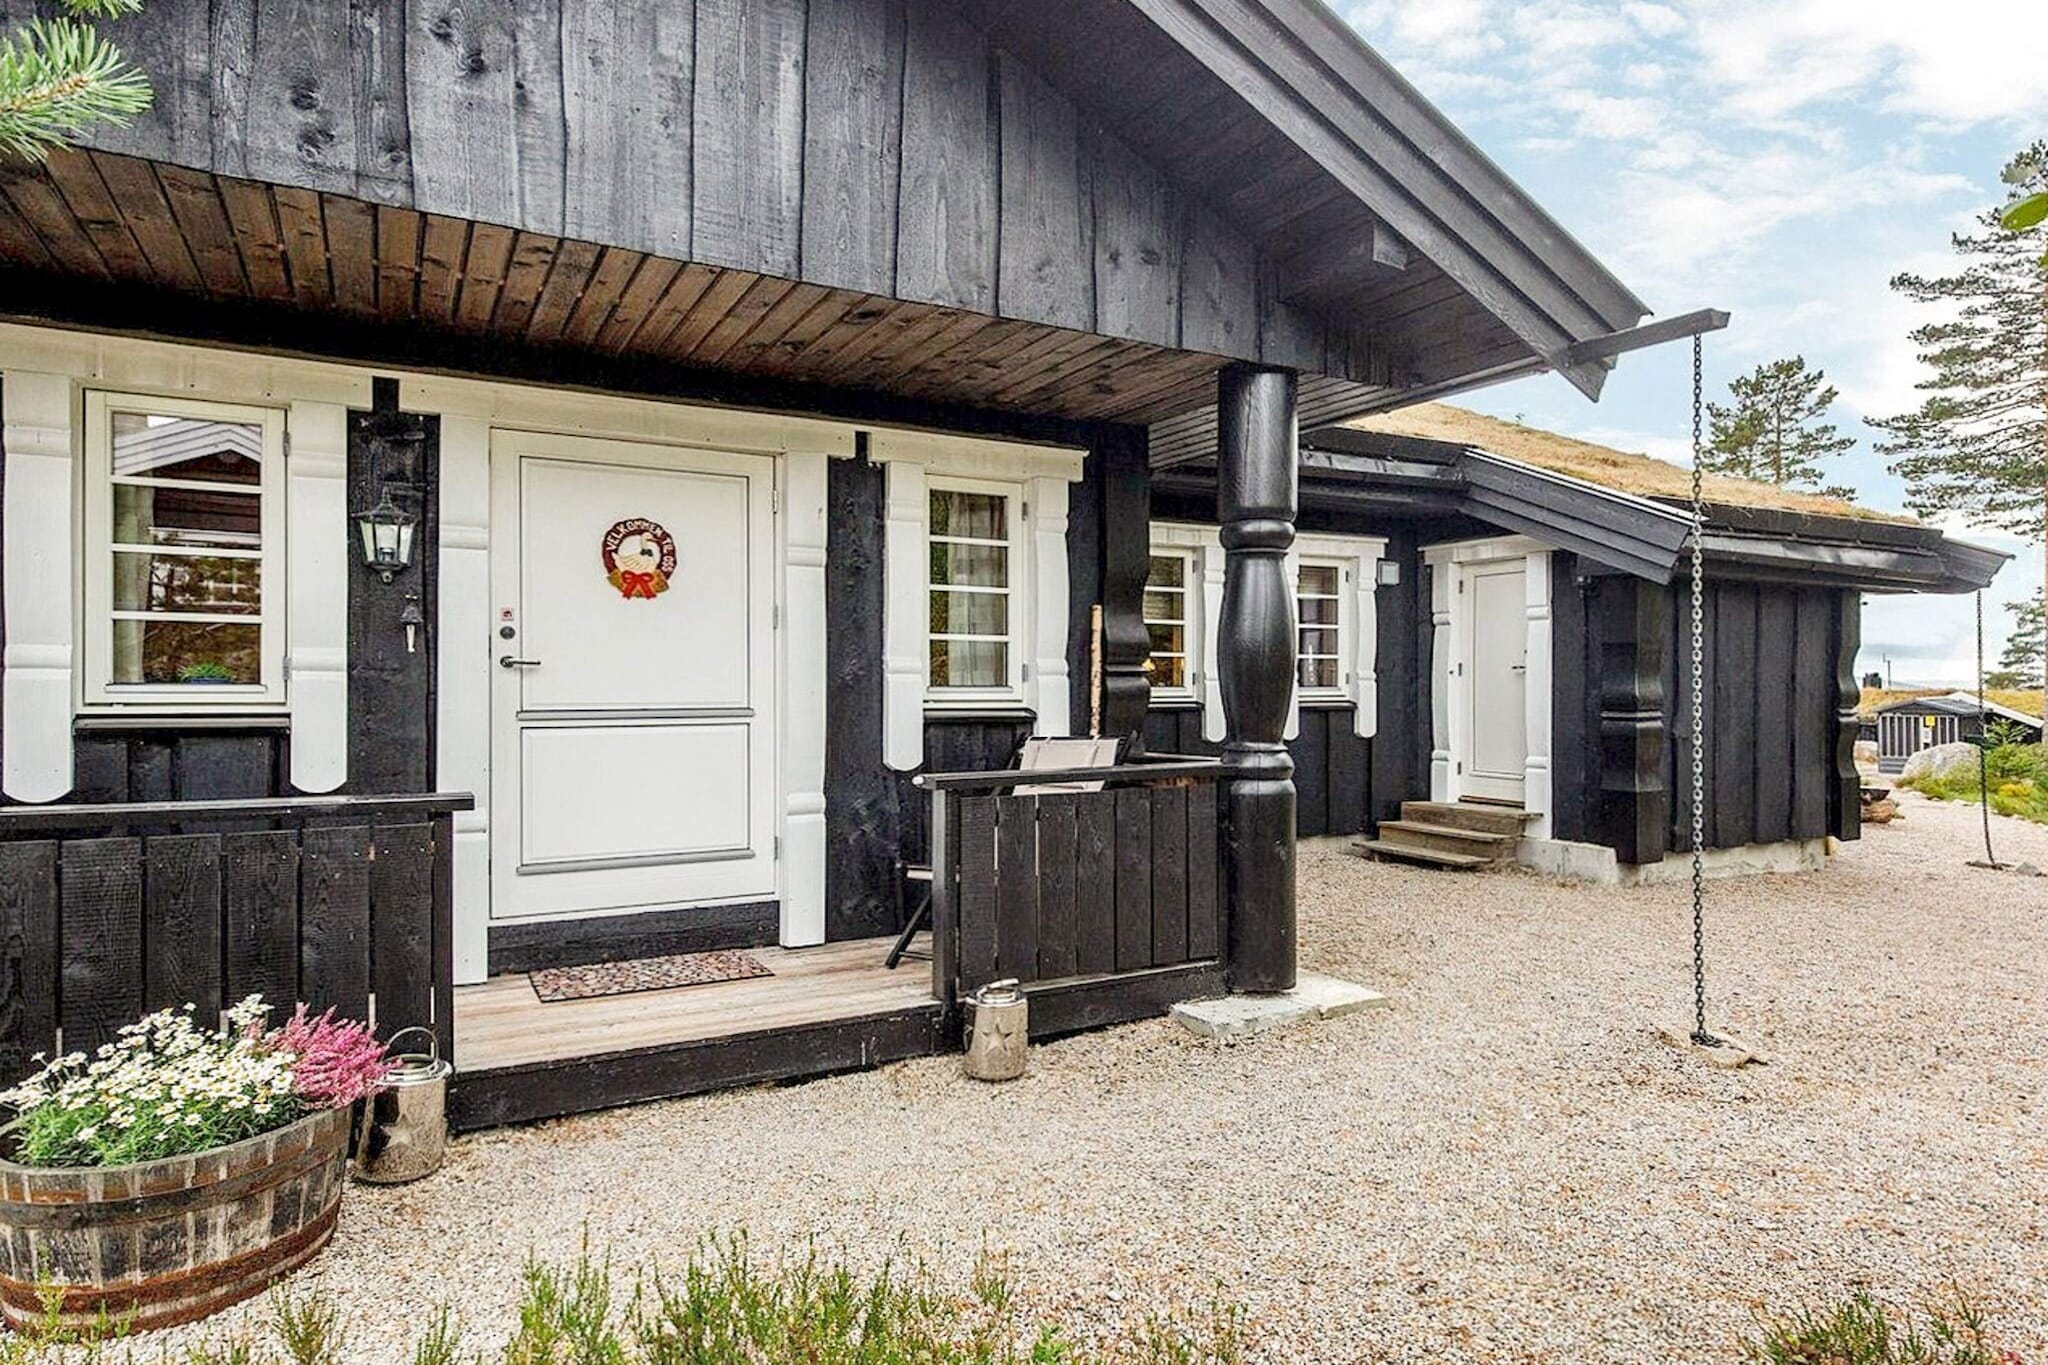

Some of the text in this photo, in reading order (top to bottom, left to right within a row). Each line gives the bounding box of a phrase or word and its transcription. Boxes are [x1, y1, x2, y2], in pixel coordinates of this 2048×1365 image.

[606, 521, 674, 572] VELKOMMEN TIL OSS
